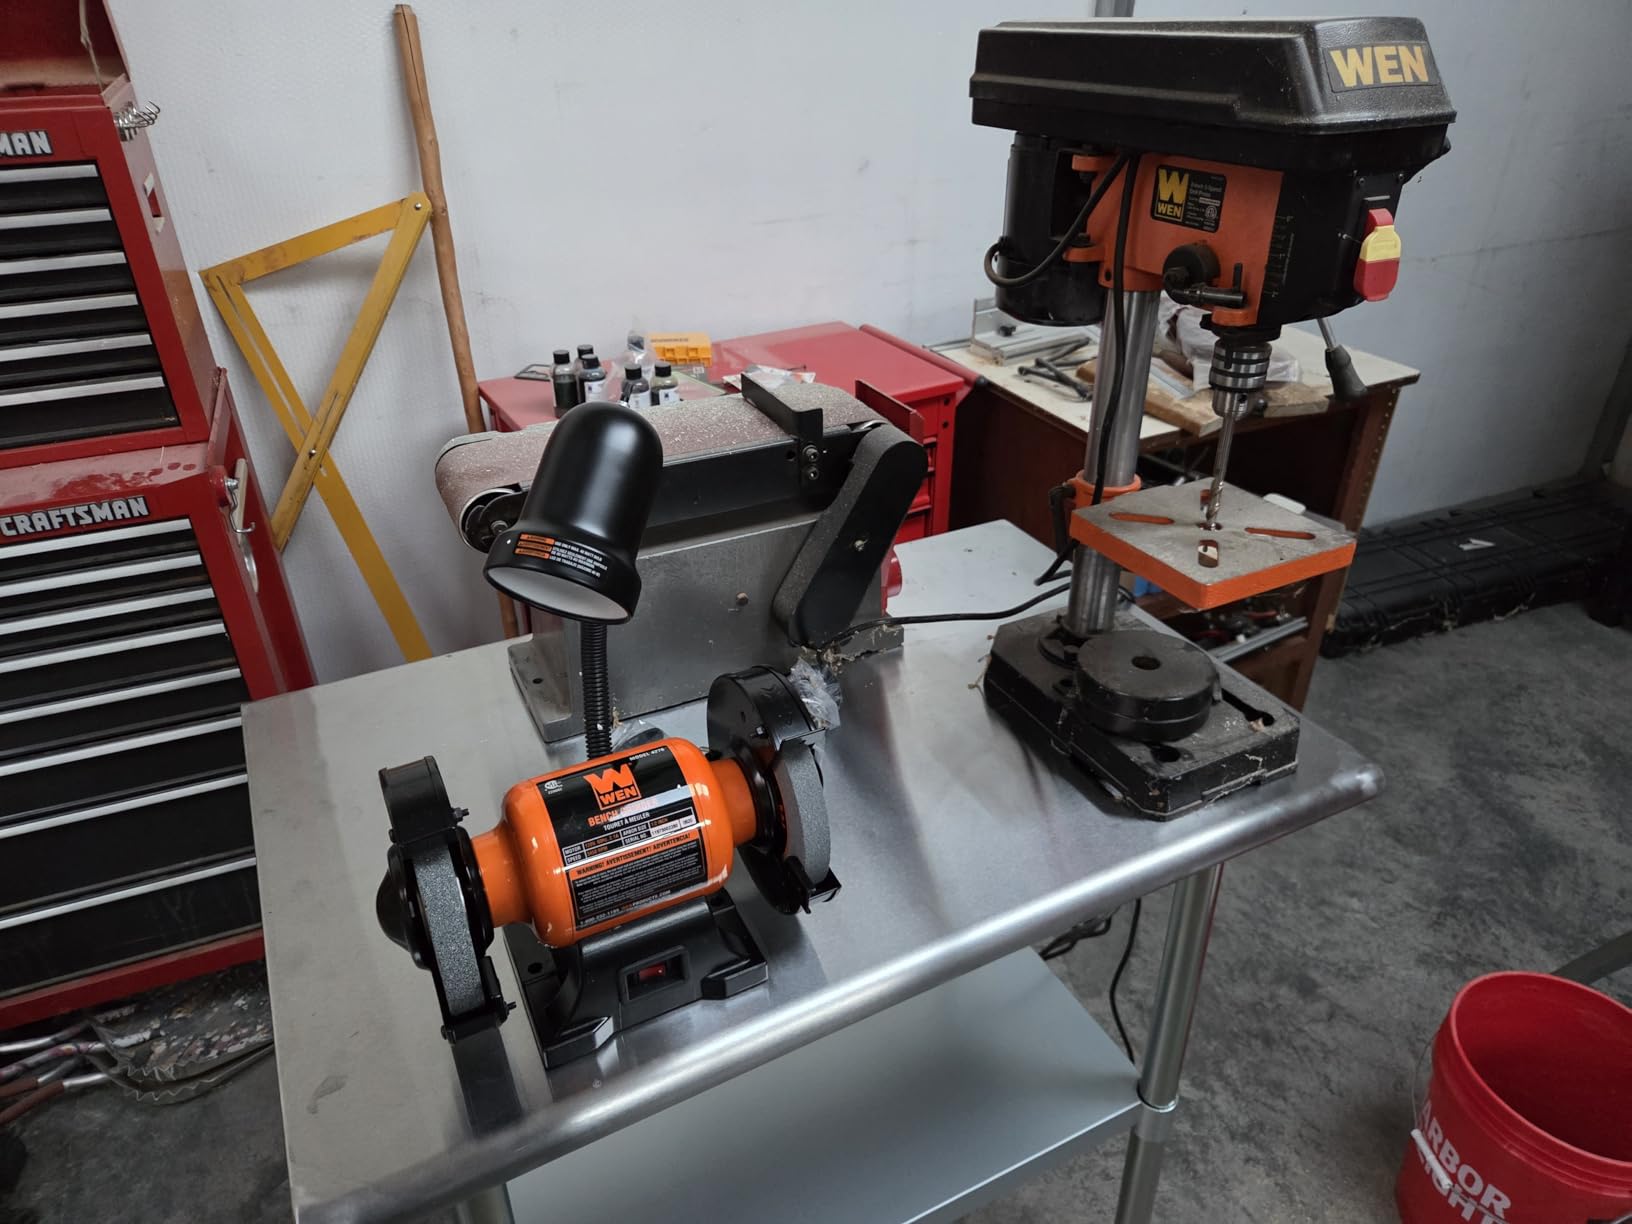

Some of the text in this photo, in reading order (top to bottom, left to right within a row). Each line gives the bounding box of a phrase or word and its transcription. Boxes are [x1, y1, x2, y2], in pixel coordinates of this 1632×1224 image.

[1330, 46, 1429, 87] WEN
[1157, 202, 1182, 218] WEN
[0, 496, 149, 537] CRAFTSMAN
[629, 751, 650, 762] MODEL
[600, 785, 638, 806] WEN
[587, 810, 620, 827] BENCH
[603, 820, 624, 831] TOURET
[629, 812, 650, 823] MEULER
[564, 845, 582, 855] MOTOR
[622, 827, 637, 836] ARBOR
[625, 835, 640, 844] SERIAL
